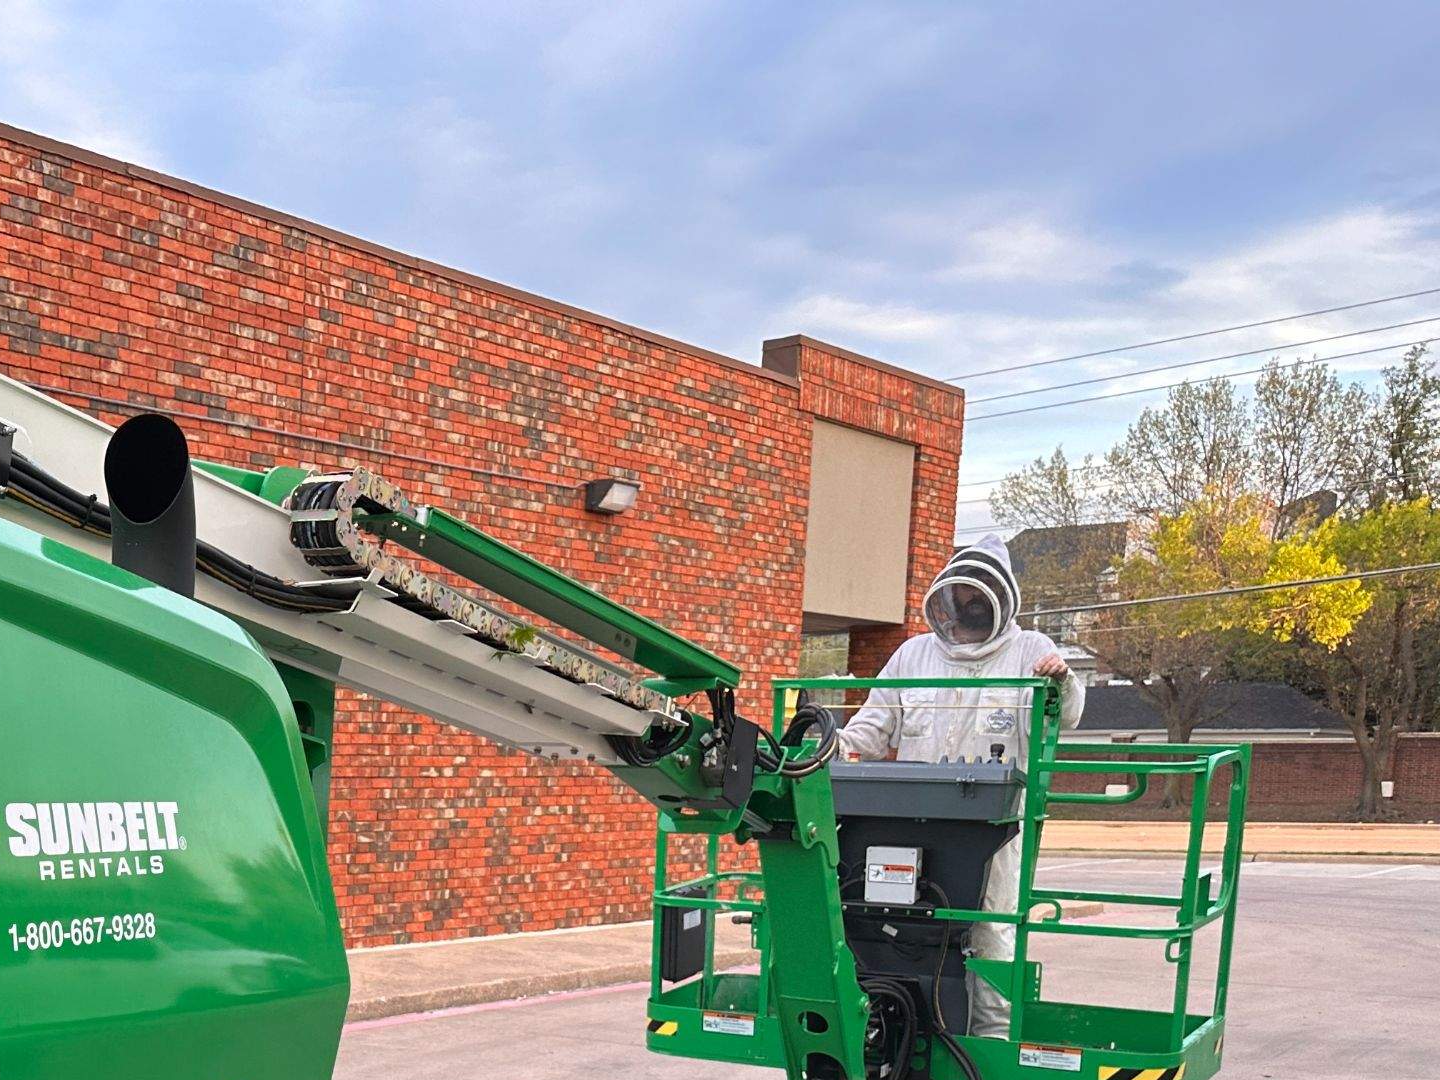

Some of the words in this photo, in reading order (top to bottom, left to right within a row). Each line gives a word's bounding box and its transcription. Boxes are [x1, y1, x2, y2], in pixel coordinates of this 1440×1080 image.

[6, 802, 179, 857] SUNBELT
[39, 855, 164, 881] RENTALS
[8, 912, 156, 952] 1-800-667-9328
